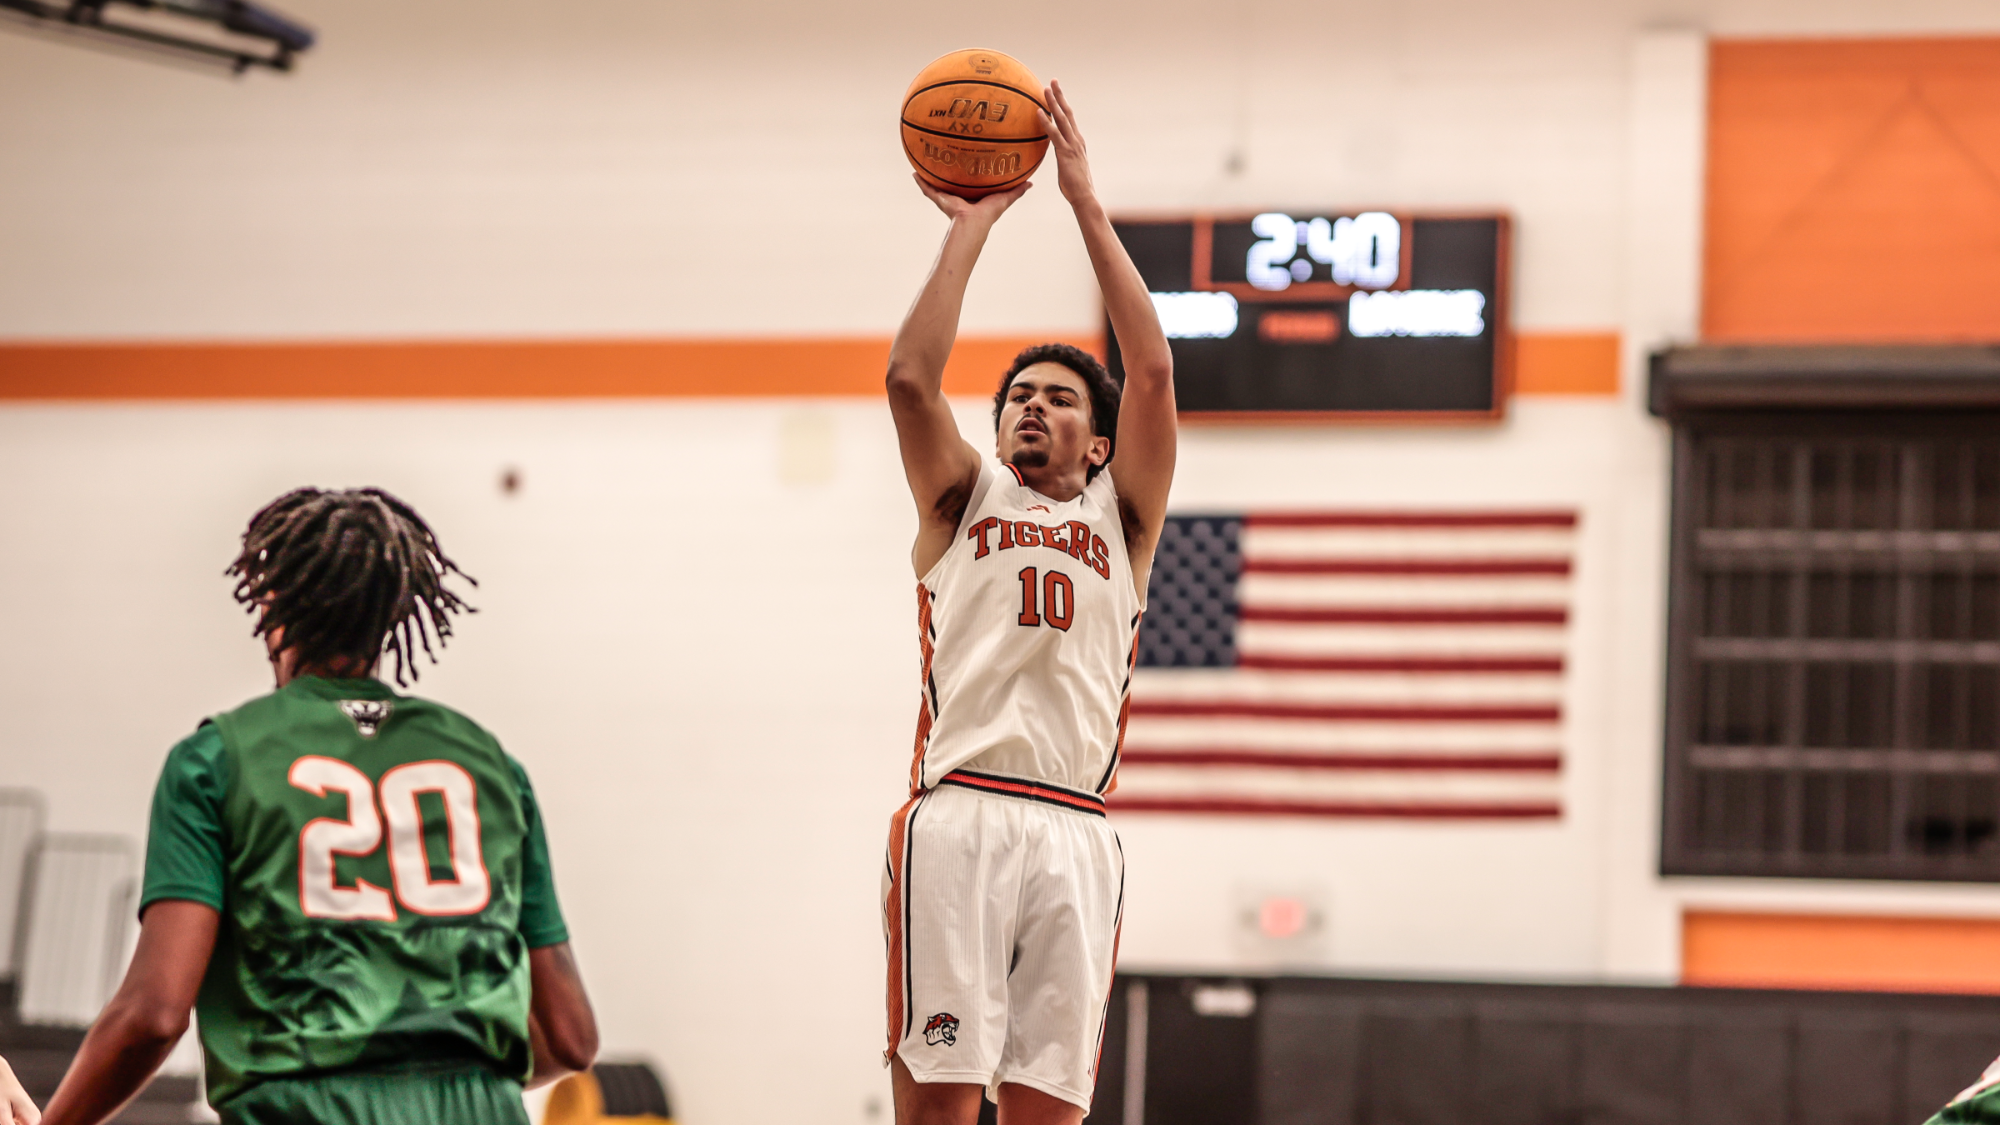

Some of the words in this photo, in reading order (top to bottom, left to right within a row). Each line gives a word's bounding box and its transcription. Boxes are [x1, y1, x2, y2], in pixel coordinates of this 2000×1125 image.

[928, 108, 946, 118] NXT
[947, 97, 1010, 123] EVO
[948, 120, 984, 134] OXY
[922, 139, 1022, 177] Wilson
[1246, 211, 1400, 291] 2:40
[967, 516, 1110, 580] TIGERS
[1018, 566, 1074, 633] 10
[287, 754, 491, 923] 20
